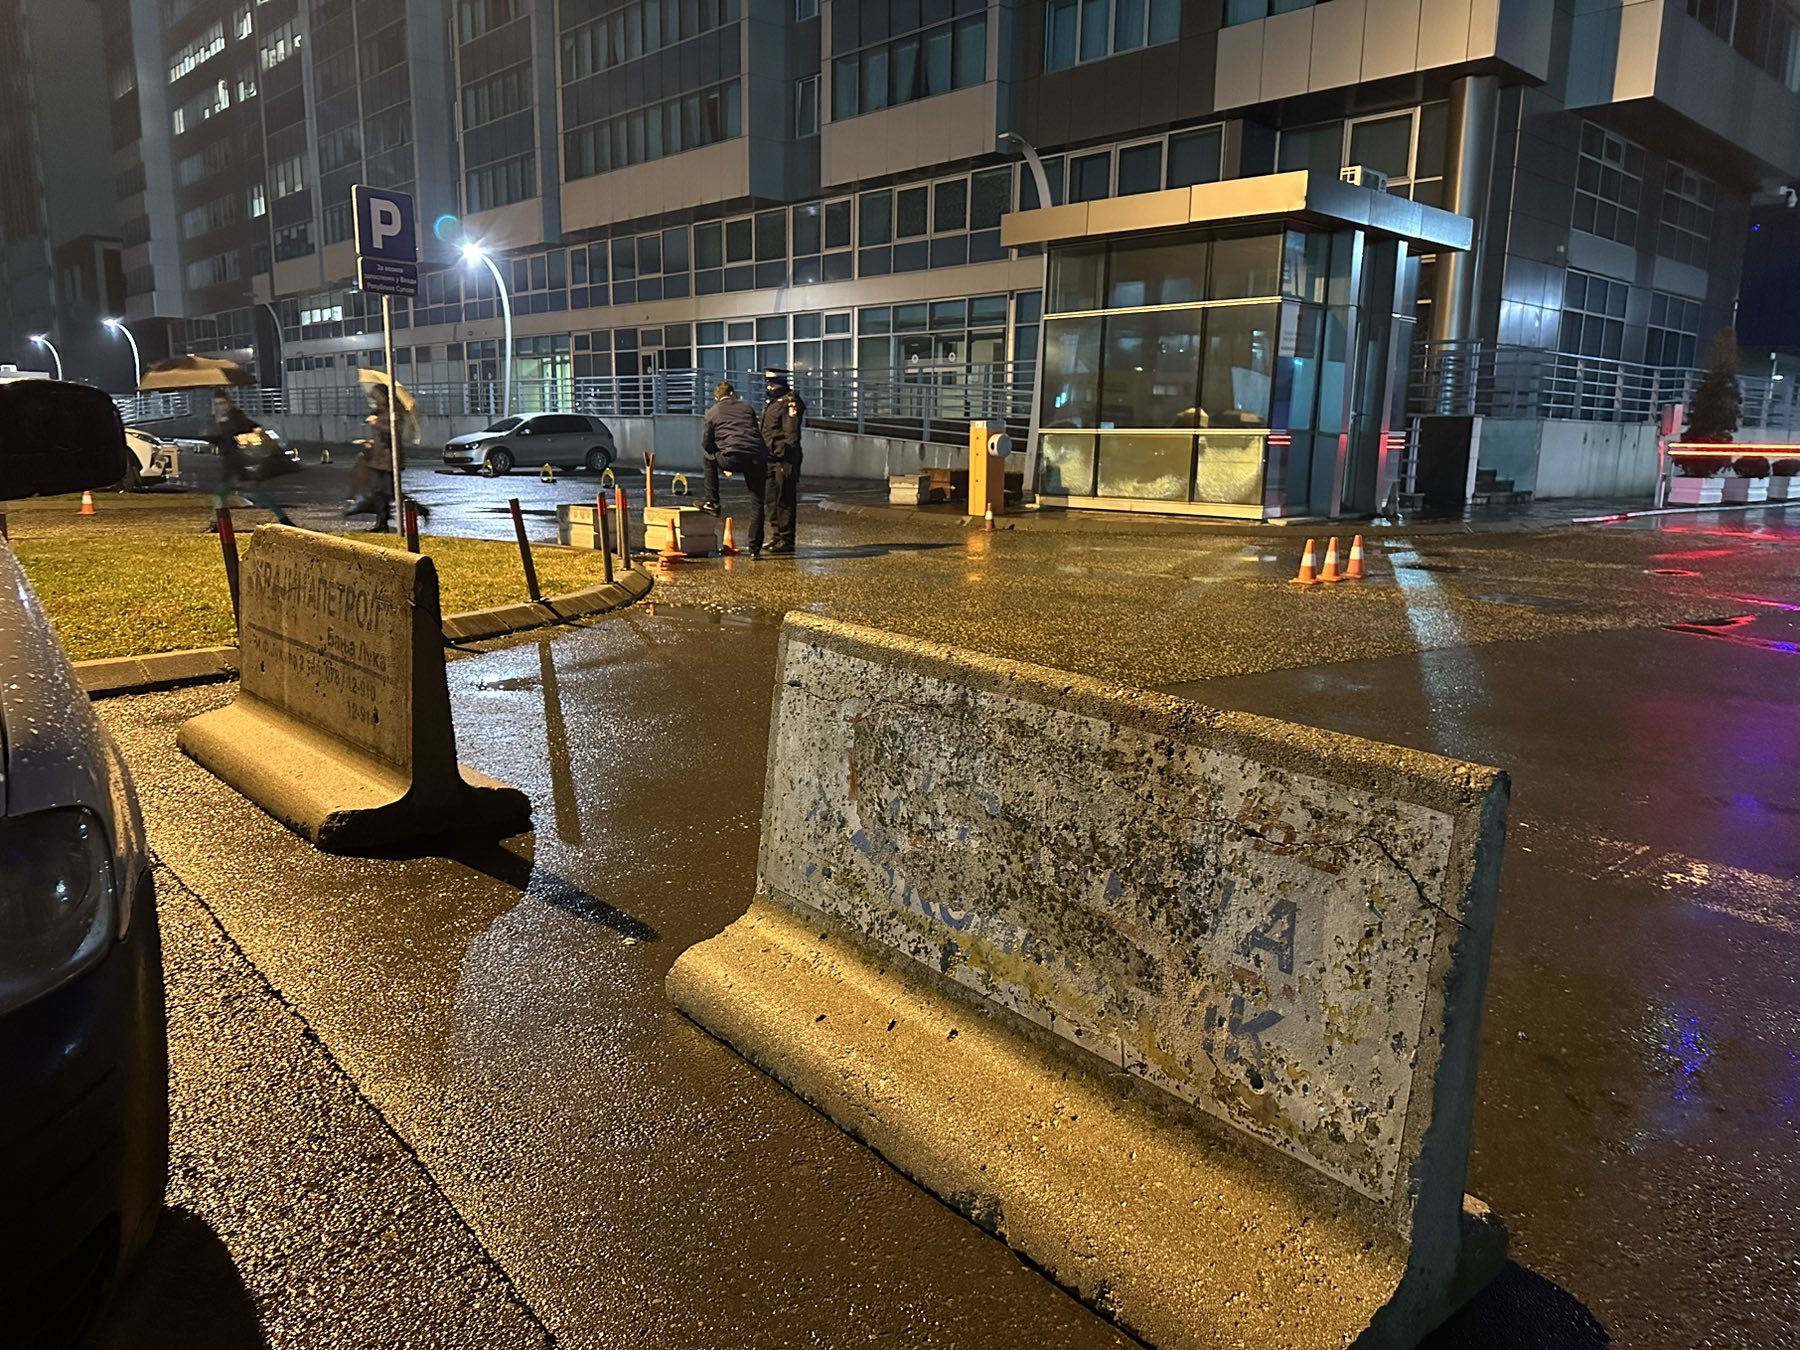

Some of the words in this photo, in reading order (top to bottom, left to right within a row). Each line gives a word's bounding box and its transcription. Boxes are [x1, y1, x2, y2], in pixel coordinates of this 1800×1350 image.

[370, 198, 402, 249] P
[327, 626, 356, 658] Бања
[359, 640, 387, 672] Лука
